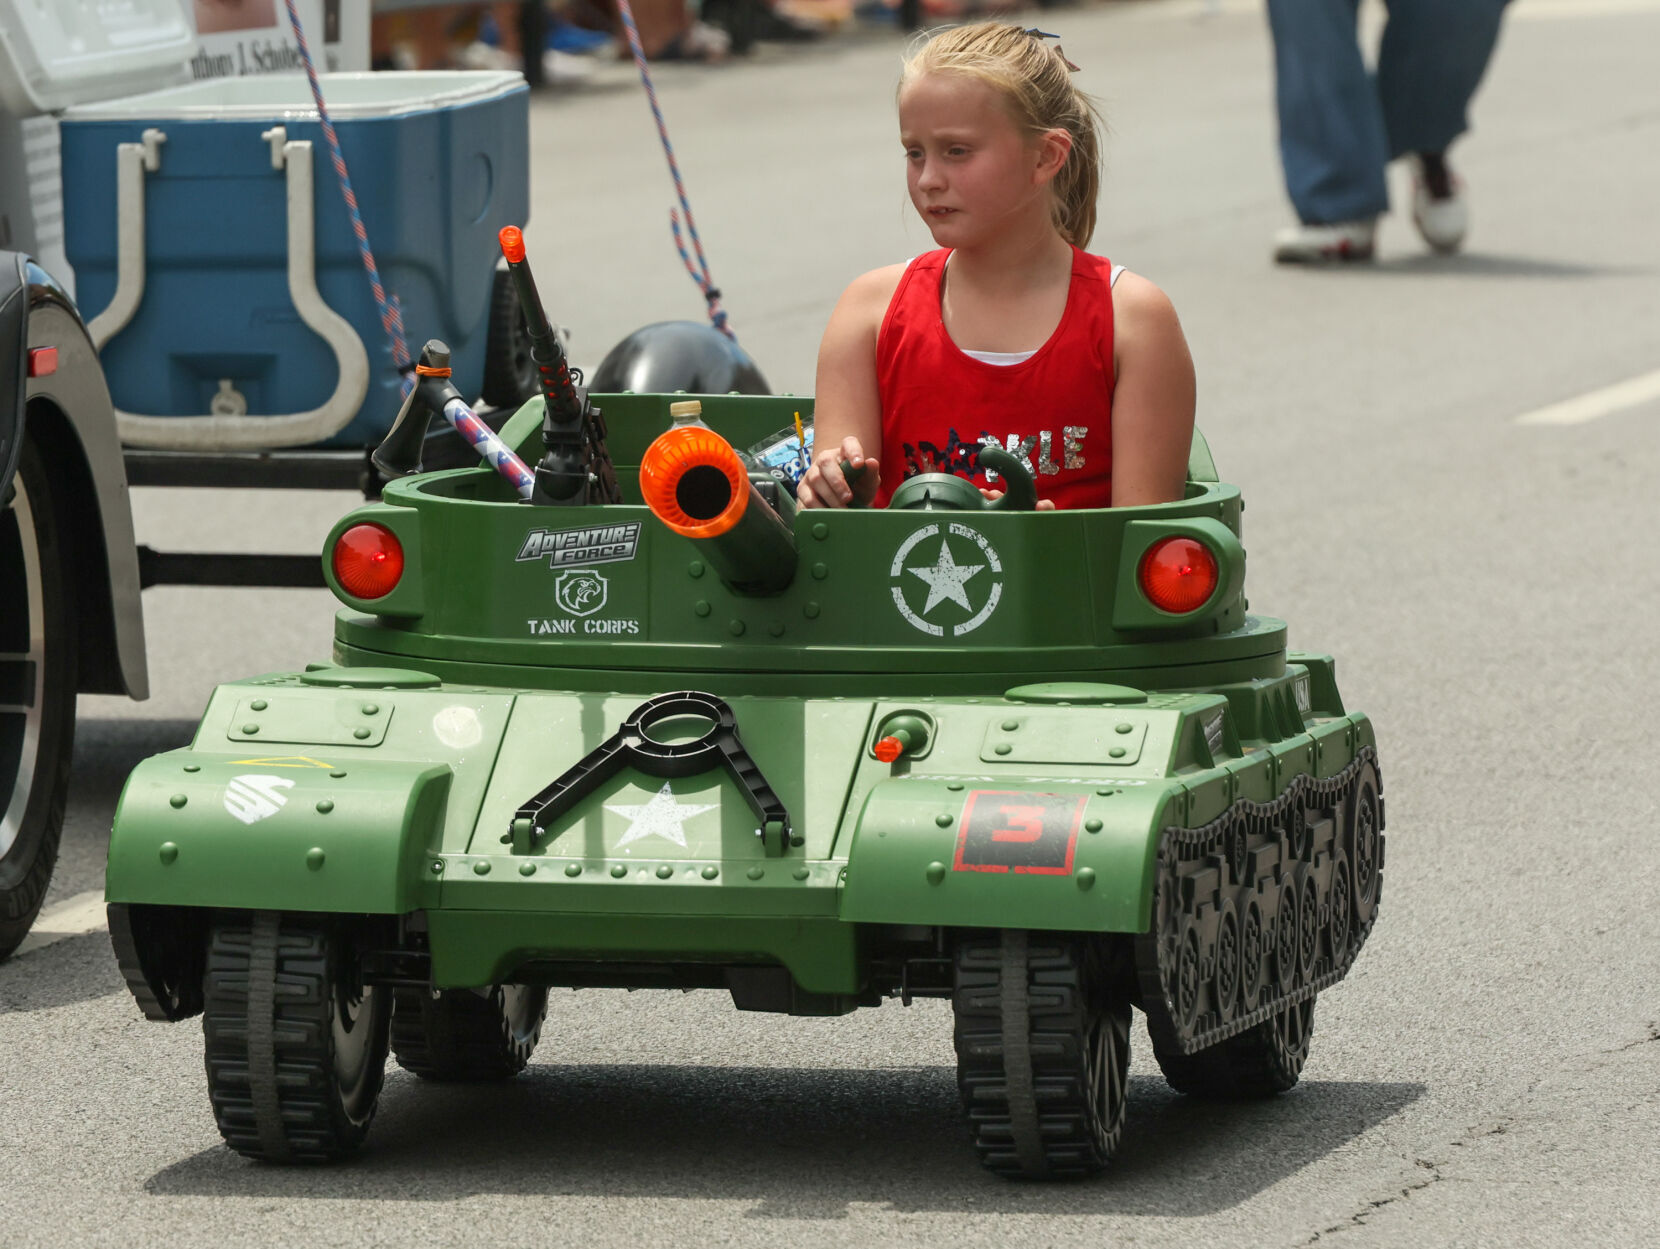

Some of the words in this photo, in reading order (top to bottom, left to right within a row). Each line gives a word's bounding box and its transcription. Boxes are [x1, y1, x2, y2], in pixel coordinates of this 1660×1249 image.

[190, 45, 234, 79] nthony
[519, 524, 638, 559] ADVENTURE
[527, 619, 577, 634] TANK
[584, 619, 640, 634] CORPS
[1295, 678, 1310, 713] USA
[991, 805, 1046, 843] 3
